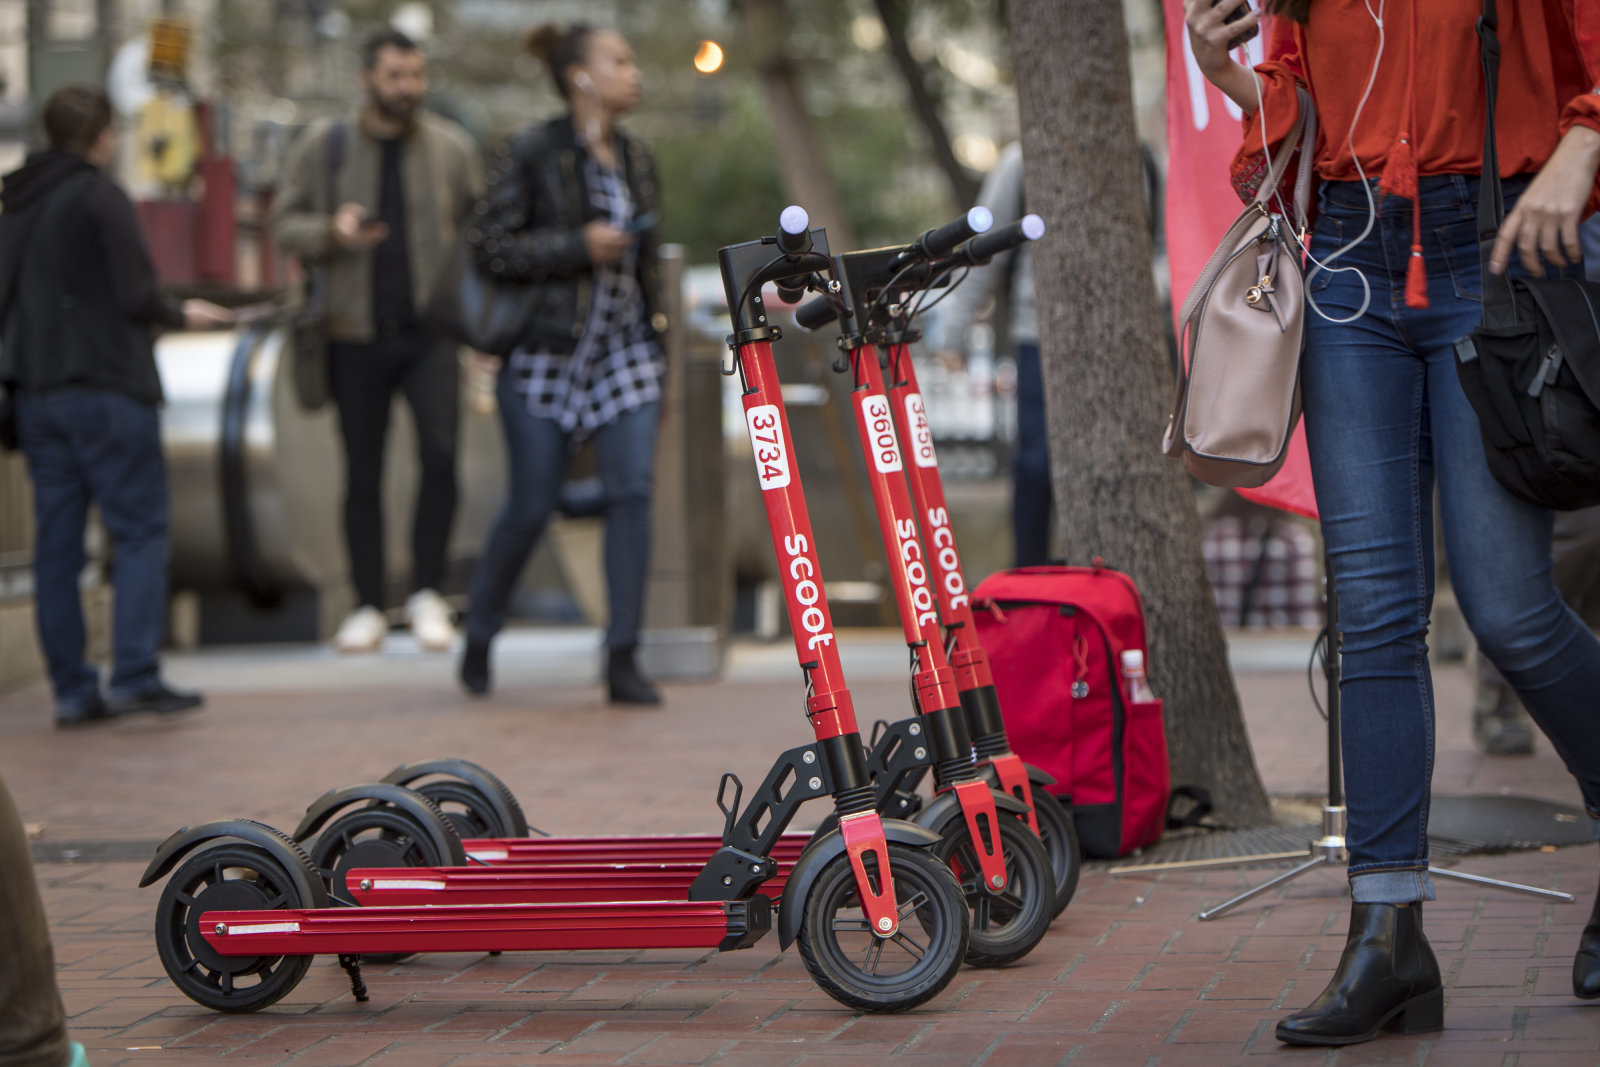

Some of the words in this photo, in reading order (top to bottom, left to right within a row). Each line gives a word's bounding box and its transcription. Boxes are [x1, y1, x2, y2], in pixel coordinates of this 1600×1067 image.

[753, 413, 784, 482] 3734
[870, 403, 898, 464] 3606
[912, 401, 936, 459] 3456
[784, 533, 834, 651] scoot
[897, 518, 937, 627] scoot
[928, 507, 969, 610] scoot
